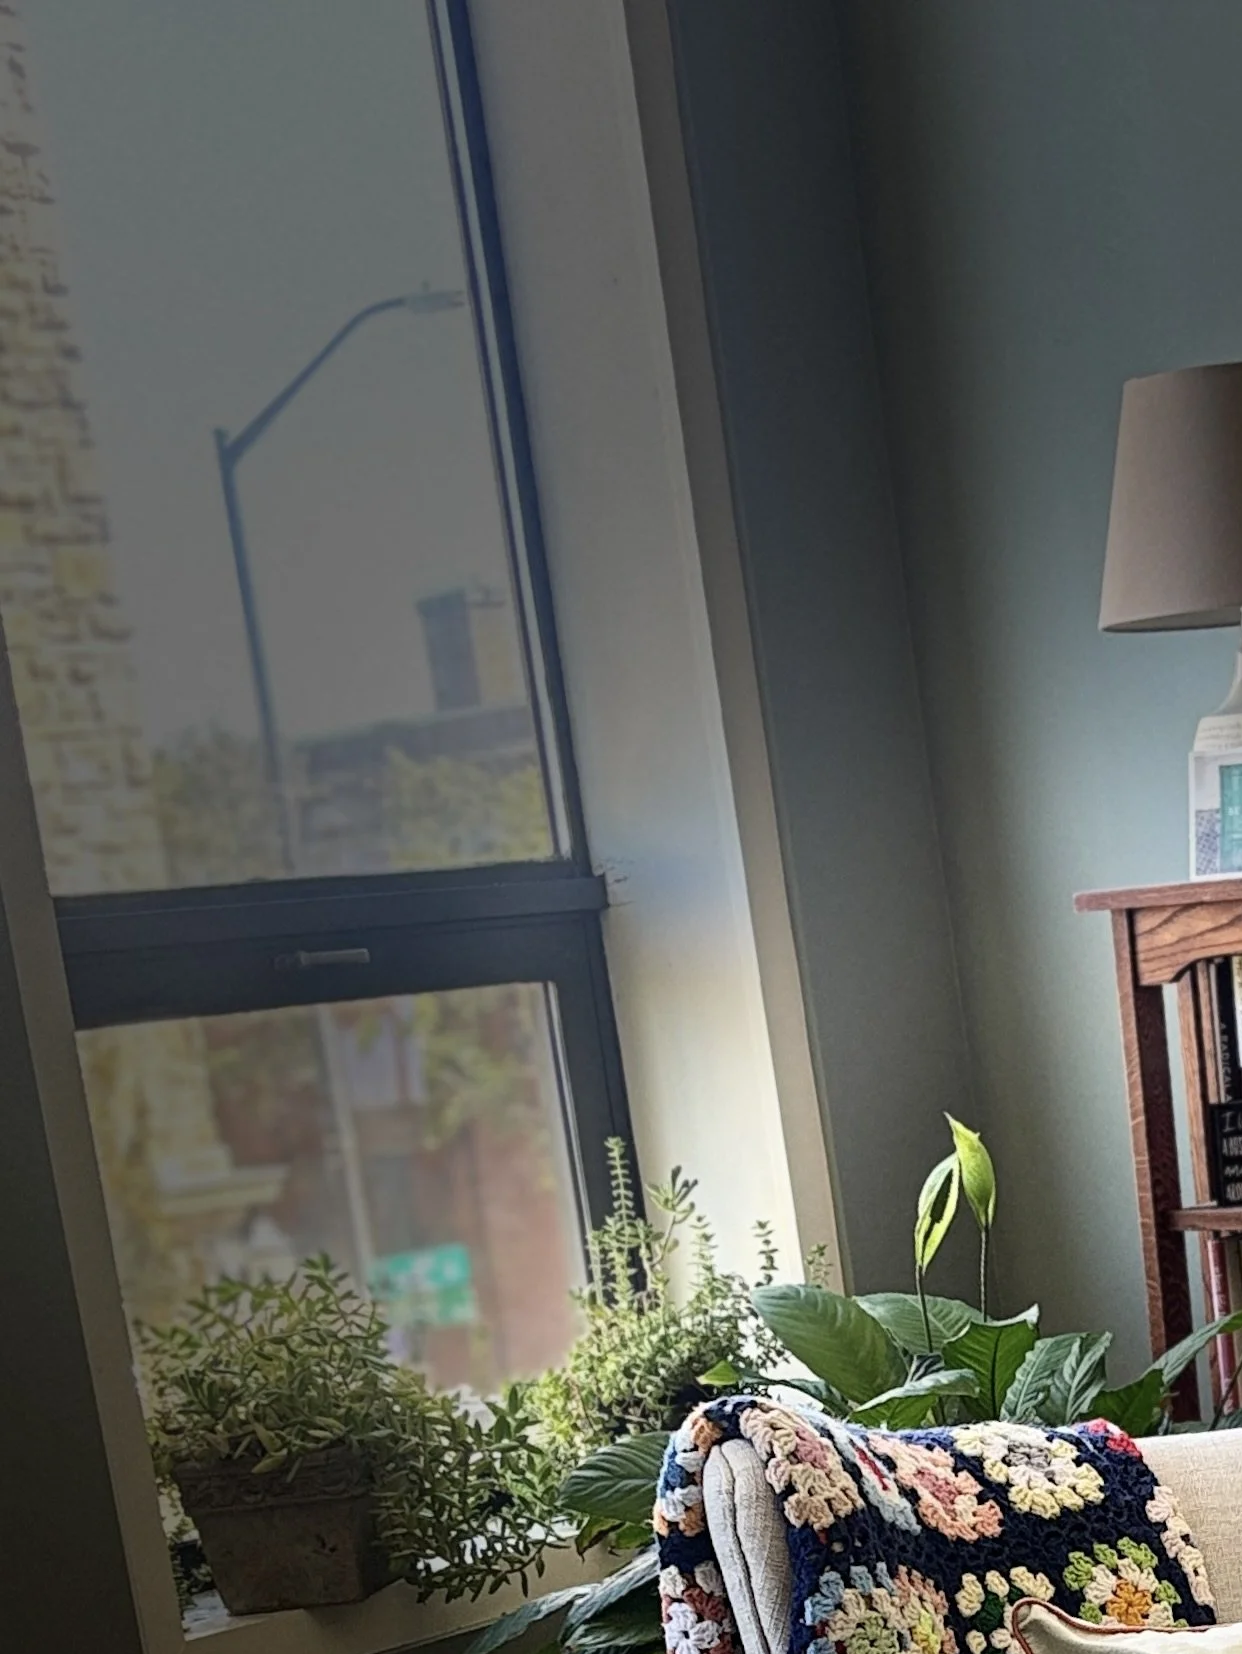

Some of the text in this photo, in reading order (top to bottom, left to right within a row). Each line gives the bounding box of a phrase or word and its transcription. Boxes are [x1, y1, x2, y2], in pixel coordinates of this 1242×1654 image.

[1228, 805, 1240, 816] BE
[1221, 1035, 1233, 1088] RADICAL
[1221, 1111, 1235, 1133] I
